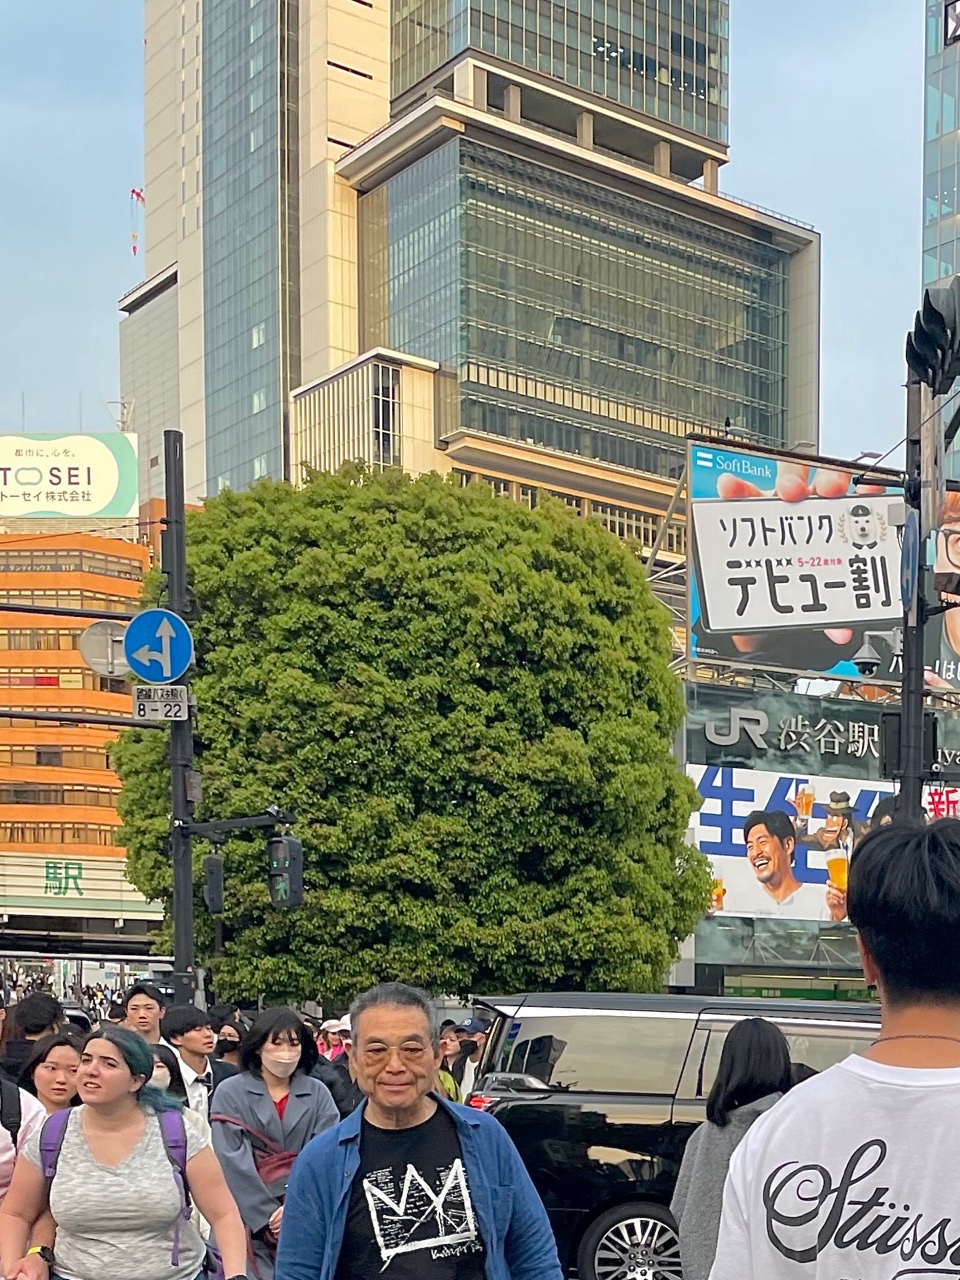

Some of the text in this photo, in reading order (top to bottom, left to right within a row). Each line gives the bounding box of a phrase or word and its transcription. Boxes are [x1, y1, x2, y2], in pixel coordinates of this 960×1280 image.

[716, 455, 772, 478] SoftBank
[719, 515, 833, 548] ソフトバンク
[726, 553, 892, 616] デビュー割
[705, 707, 880, 758] JR 渋谷駅
[44, 860, 84, 897] 駅
